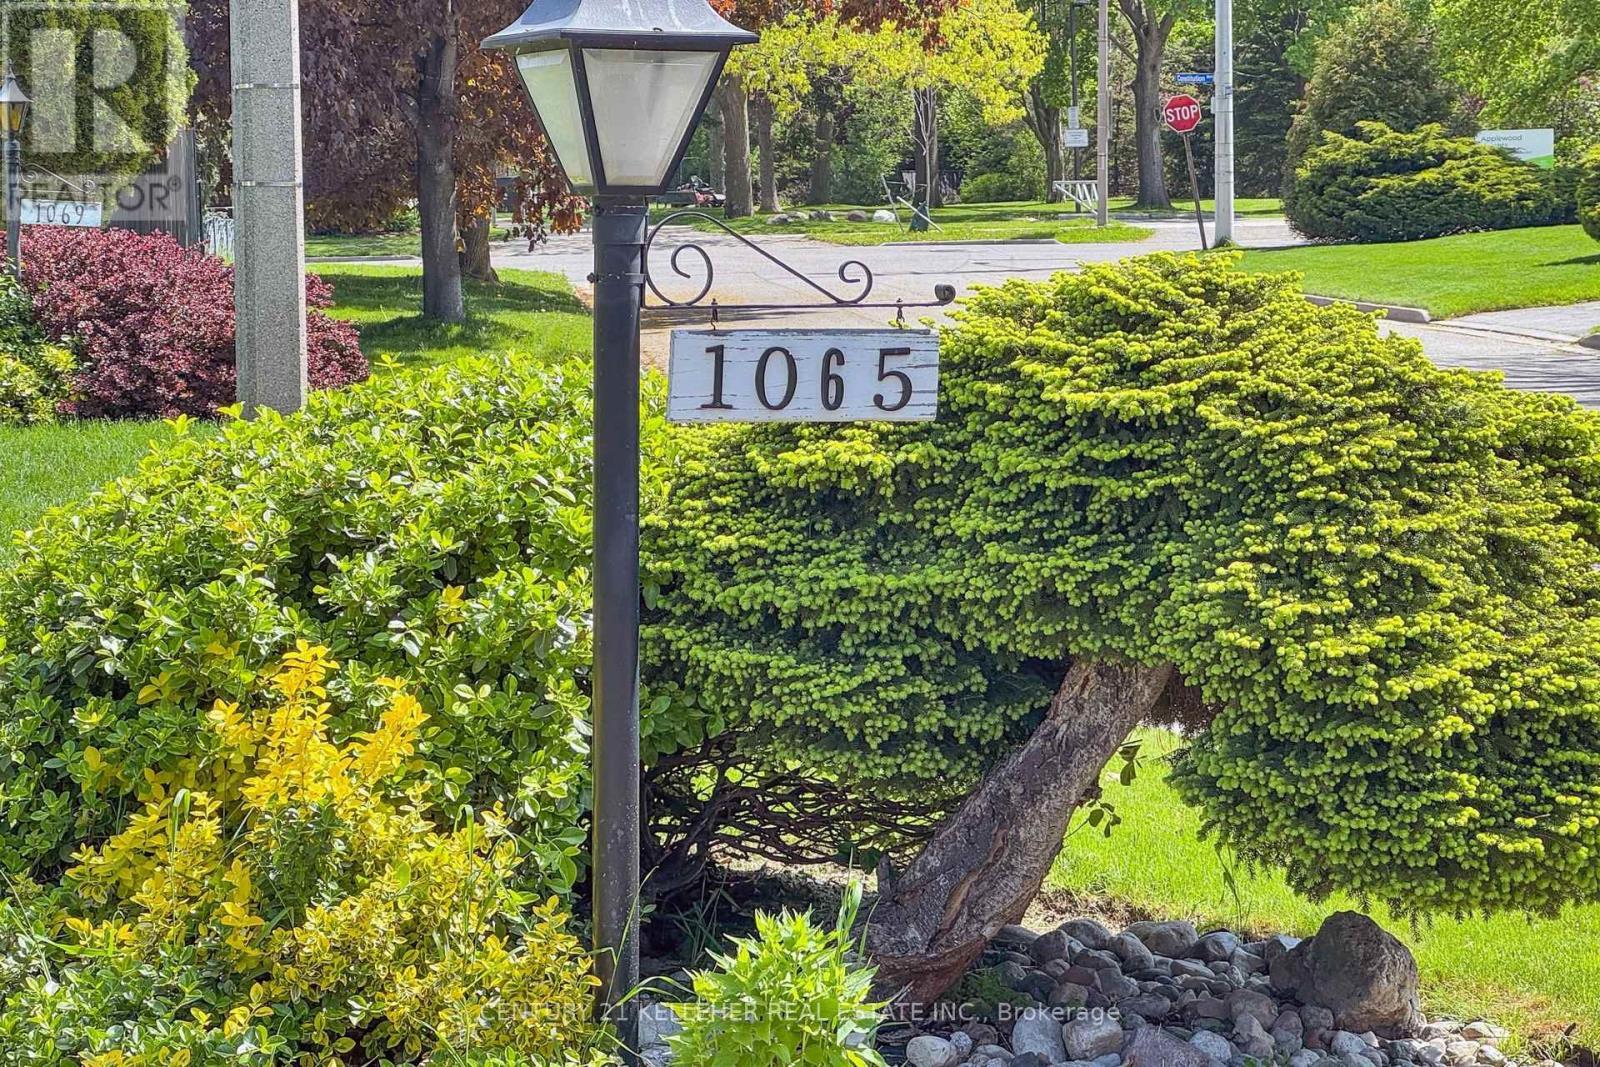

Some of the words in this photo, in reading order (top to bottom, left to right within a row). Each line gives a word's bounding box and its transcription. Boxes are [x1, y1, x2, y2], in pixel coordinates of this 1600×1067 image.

[1166, 105, 1198, 122] STOP
[35, 203, 84, 225] 1069
[700, 344, 913, 411] 1065
